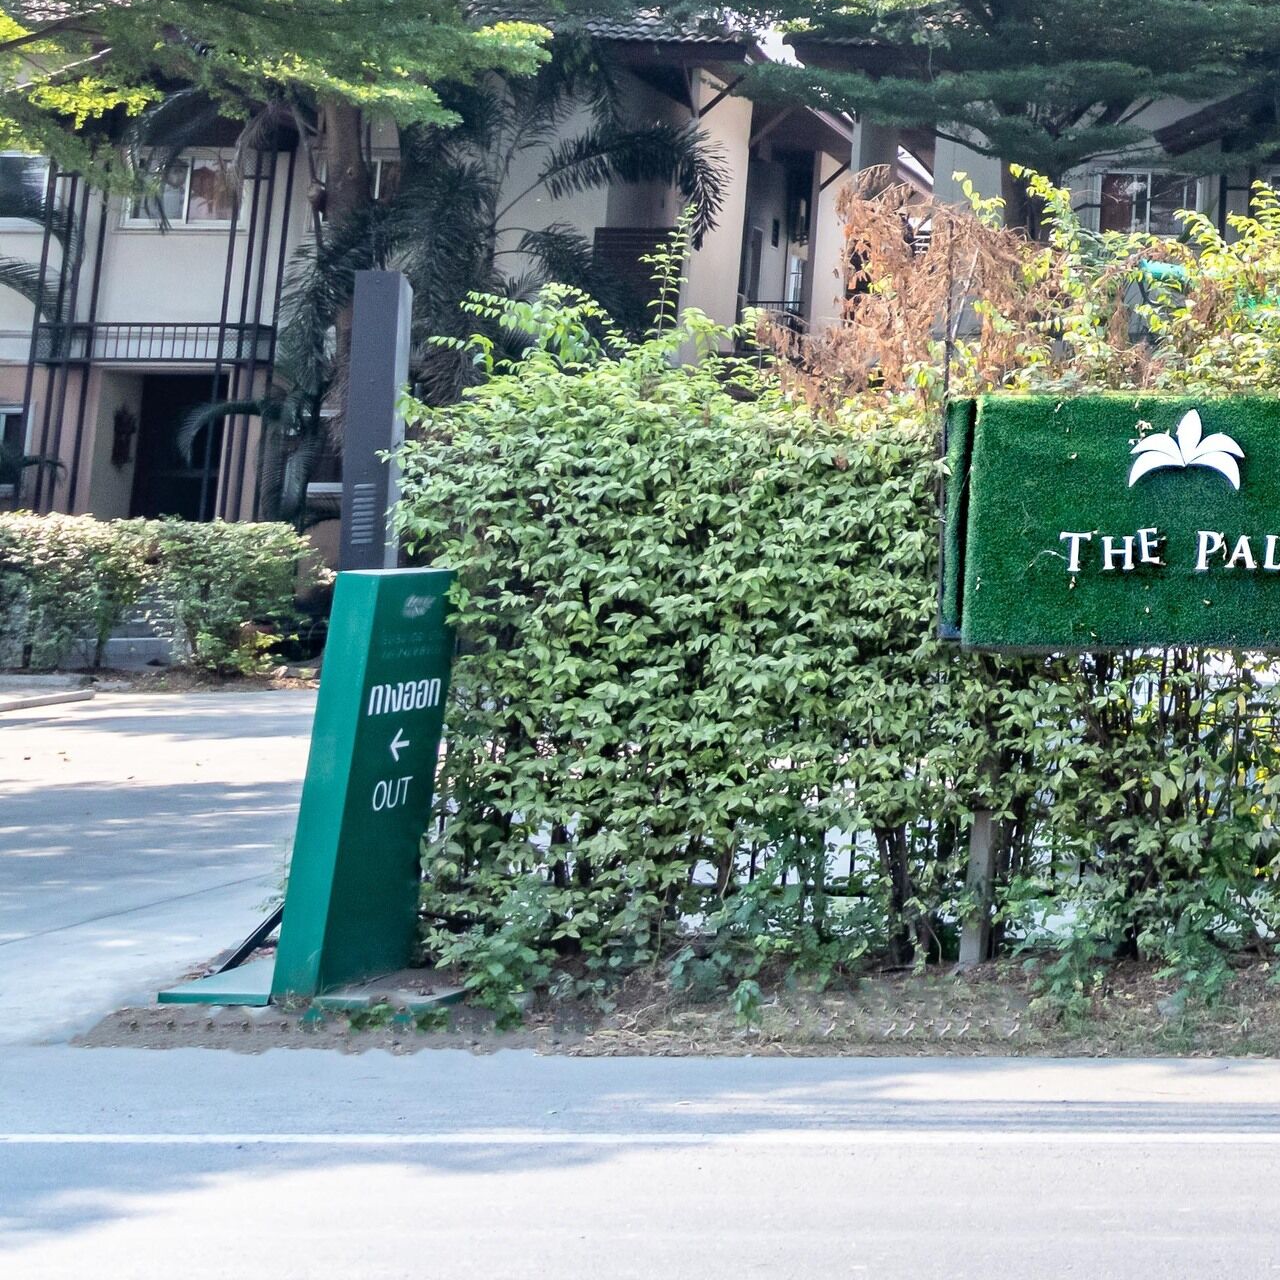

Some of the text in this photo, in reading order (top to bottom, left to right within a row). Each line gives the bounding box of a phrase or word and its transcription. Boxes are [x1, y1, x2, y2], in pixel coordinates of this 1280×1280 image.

[1059, 527, 1161, 572] THE
[367, 677, 441, 716] ทางออก
[372, 775, 414, 812] OUT
